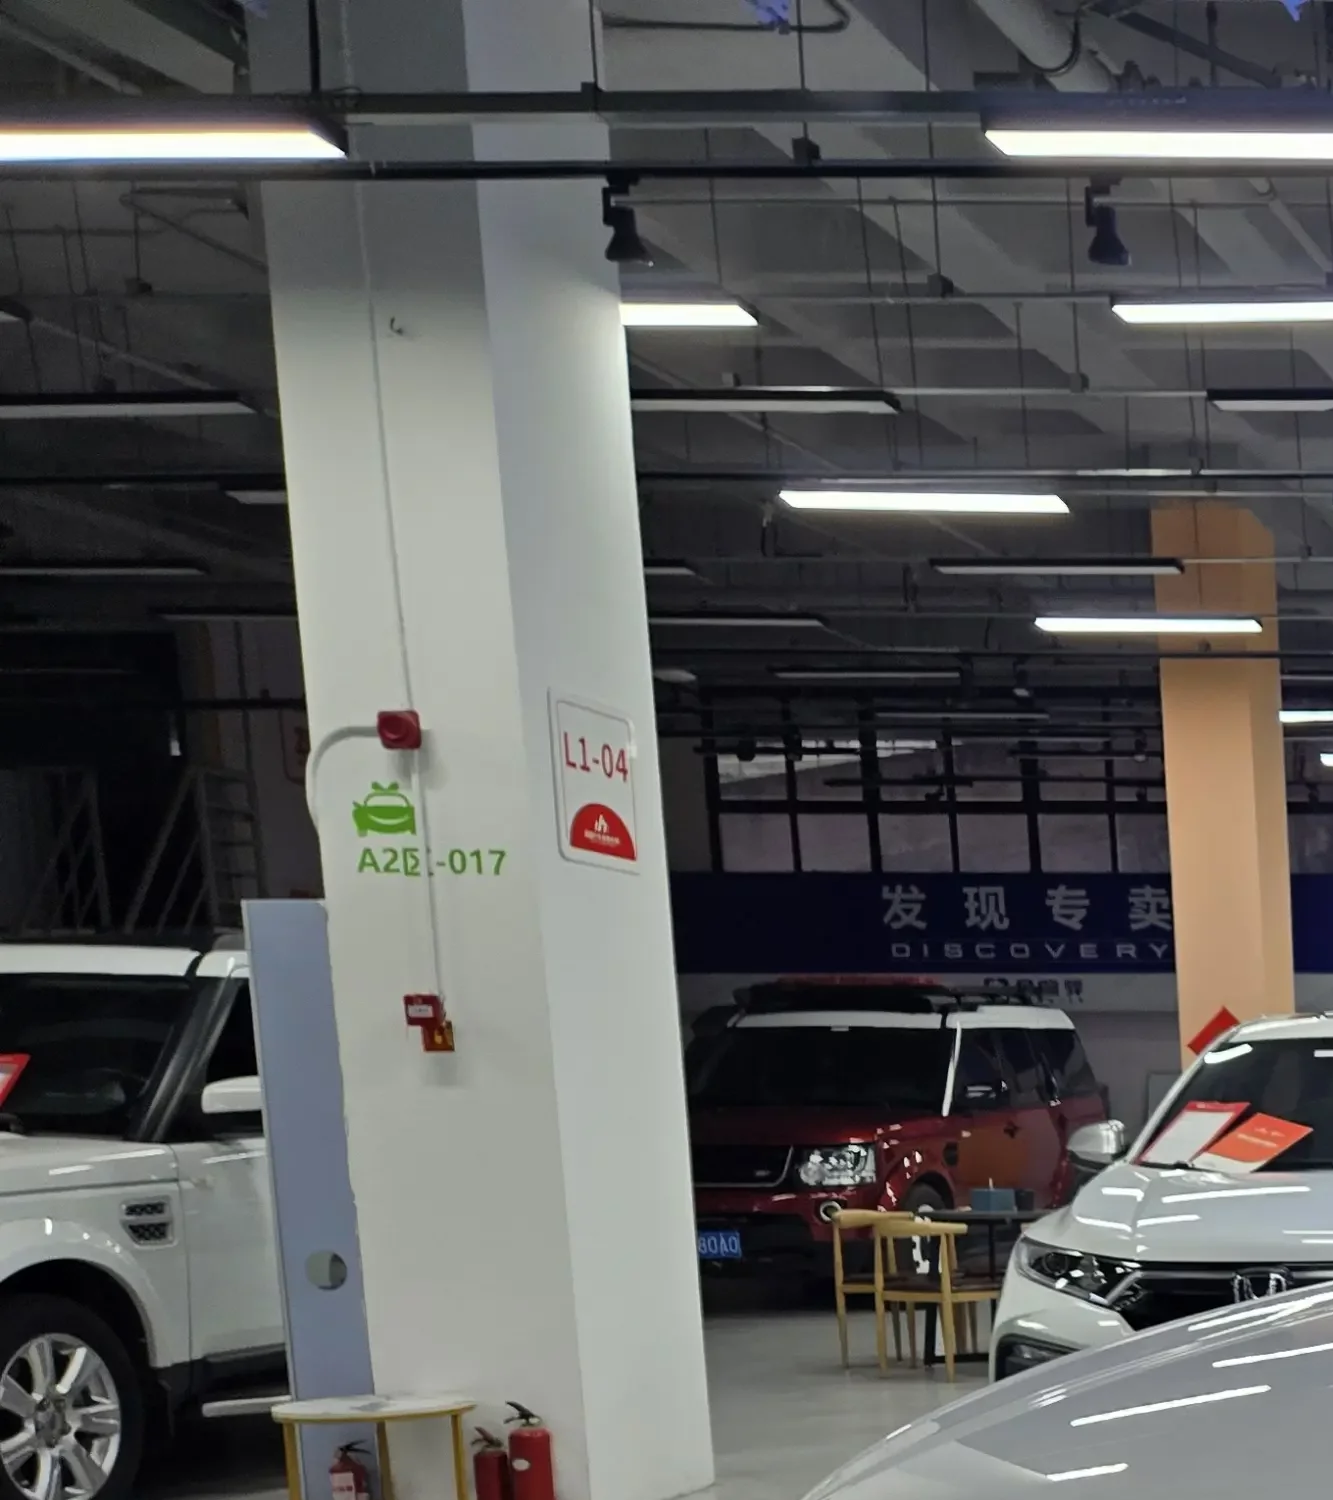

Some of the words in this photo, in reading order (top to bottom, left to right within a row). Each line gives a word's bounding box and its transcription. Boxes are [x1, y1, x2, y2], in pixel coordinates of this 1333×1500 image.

[563, 730, 629, 783] L1-04
[881, 884, 1173, 931] 发现专卖
[890, 942, 1170, 959] DISCOVERY
